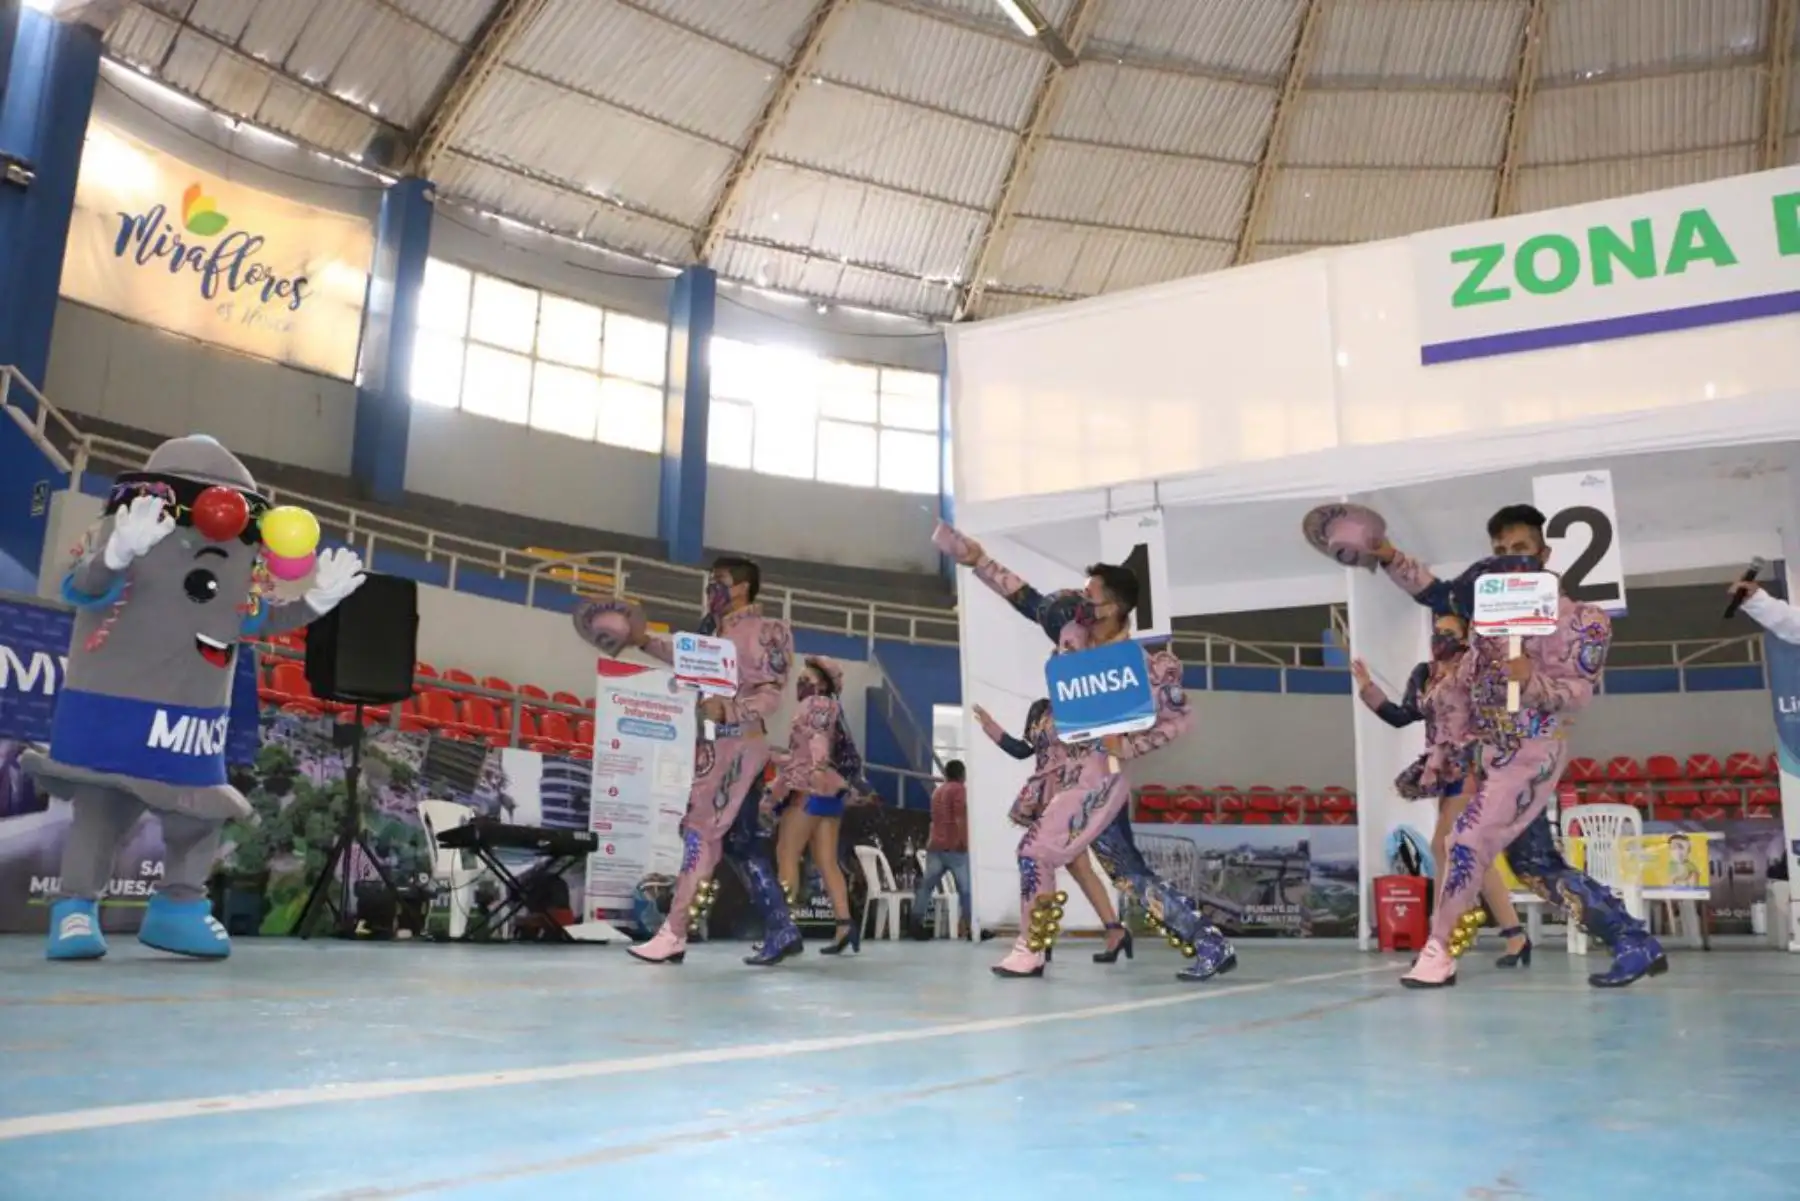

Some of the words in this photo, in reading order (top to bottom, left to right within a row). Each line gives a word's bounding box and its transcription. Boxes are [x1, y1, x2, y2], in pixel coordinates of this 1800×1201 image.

[115, 203, 314, 312] Miraflores
[1450, 208, 1739, 308] ZONA
[1120, 543, 1153, 631] 1
[1546, 505, 1621, 603] 2
[0, 644, 68, 695] M
[1056, 665, 1139, 702] MINSA
[1778, 695, 1800, 713] Li
[147, 708, 230, 757] MINS
